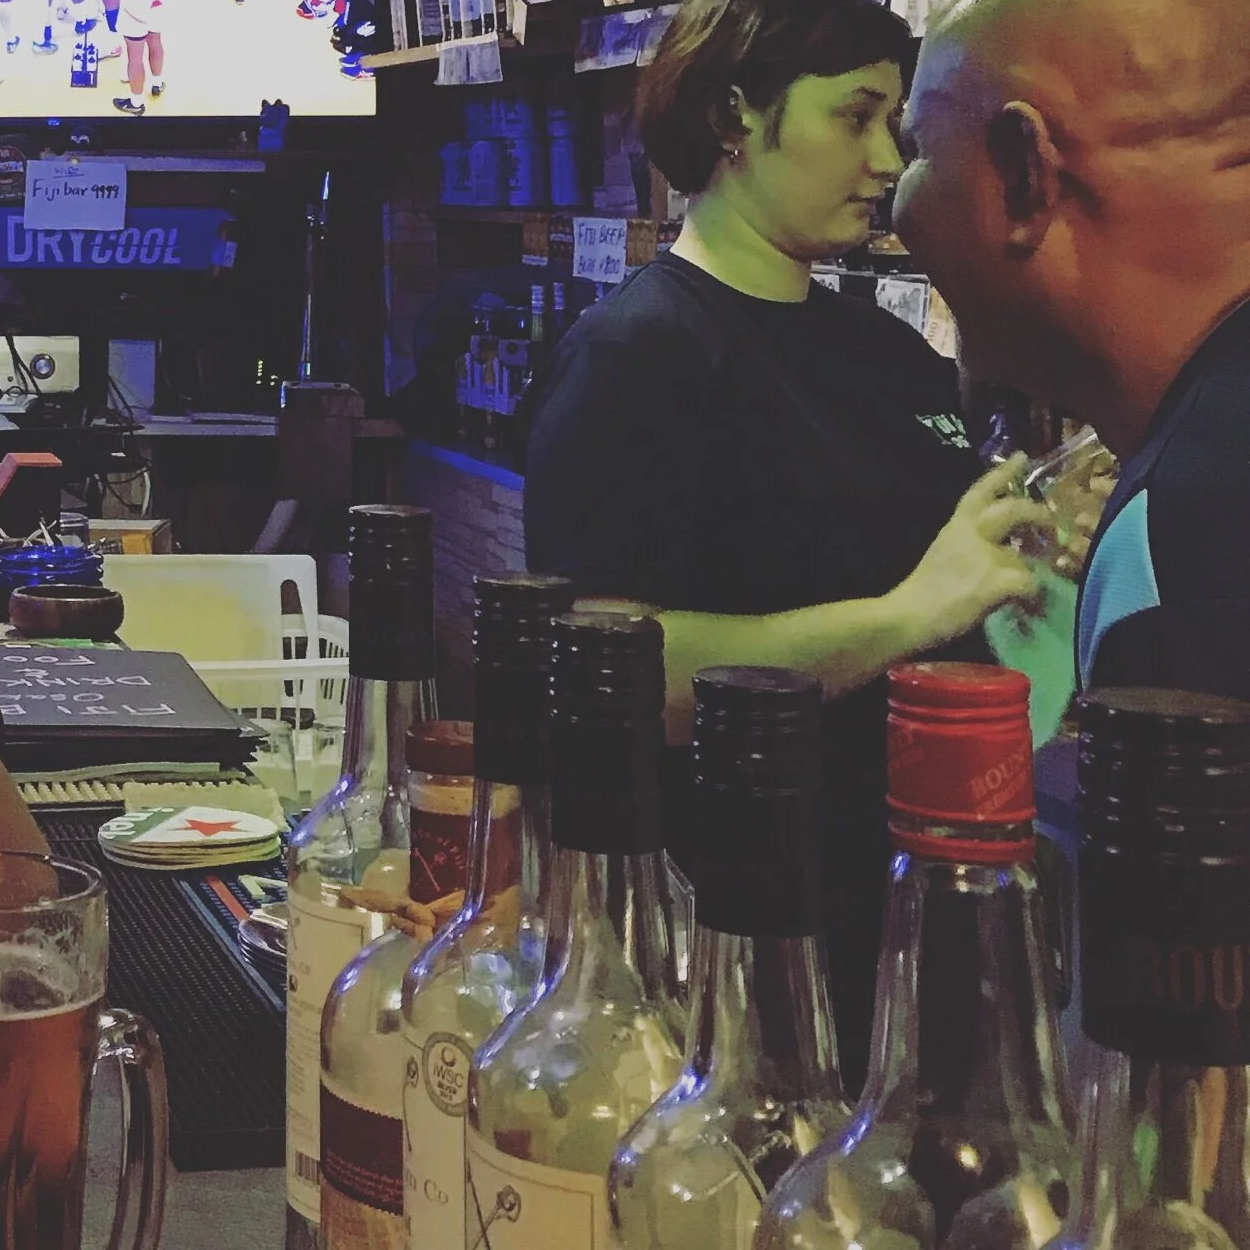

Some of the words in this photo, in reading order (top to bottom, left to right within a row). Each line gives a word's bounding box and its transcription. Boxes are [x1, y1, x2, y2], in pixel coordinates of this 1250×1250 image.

[90, 184, 120, 199] 9999
[56, 702, 177, 716] FIJI
[433, 1064, 465, 1089] IWSC
